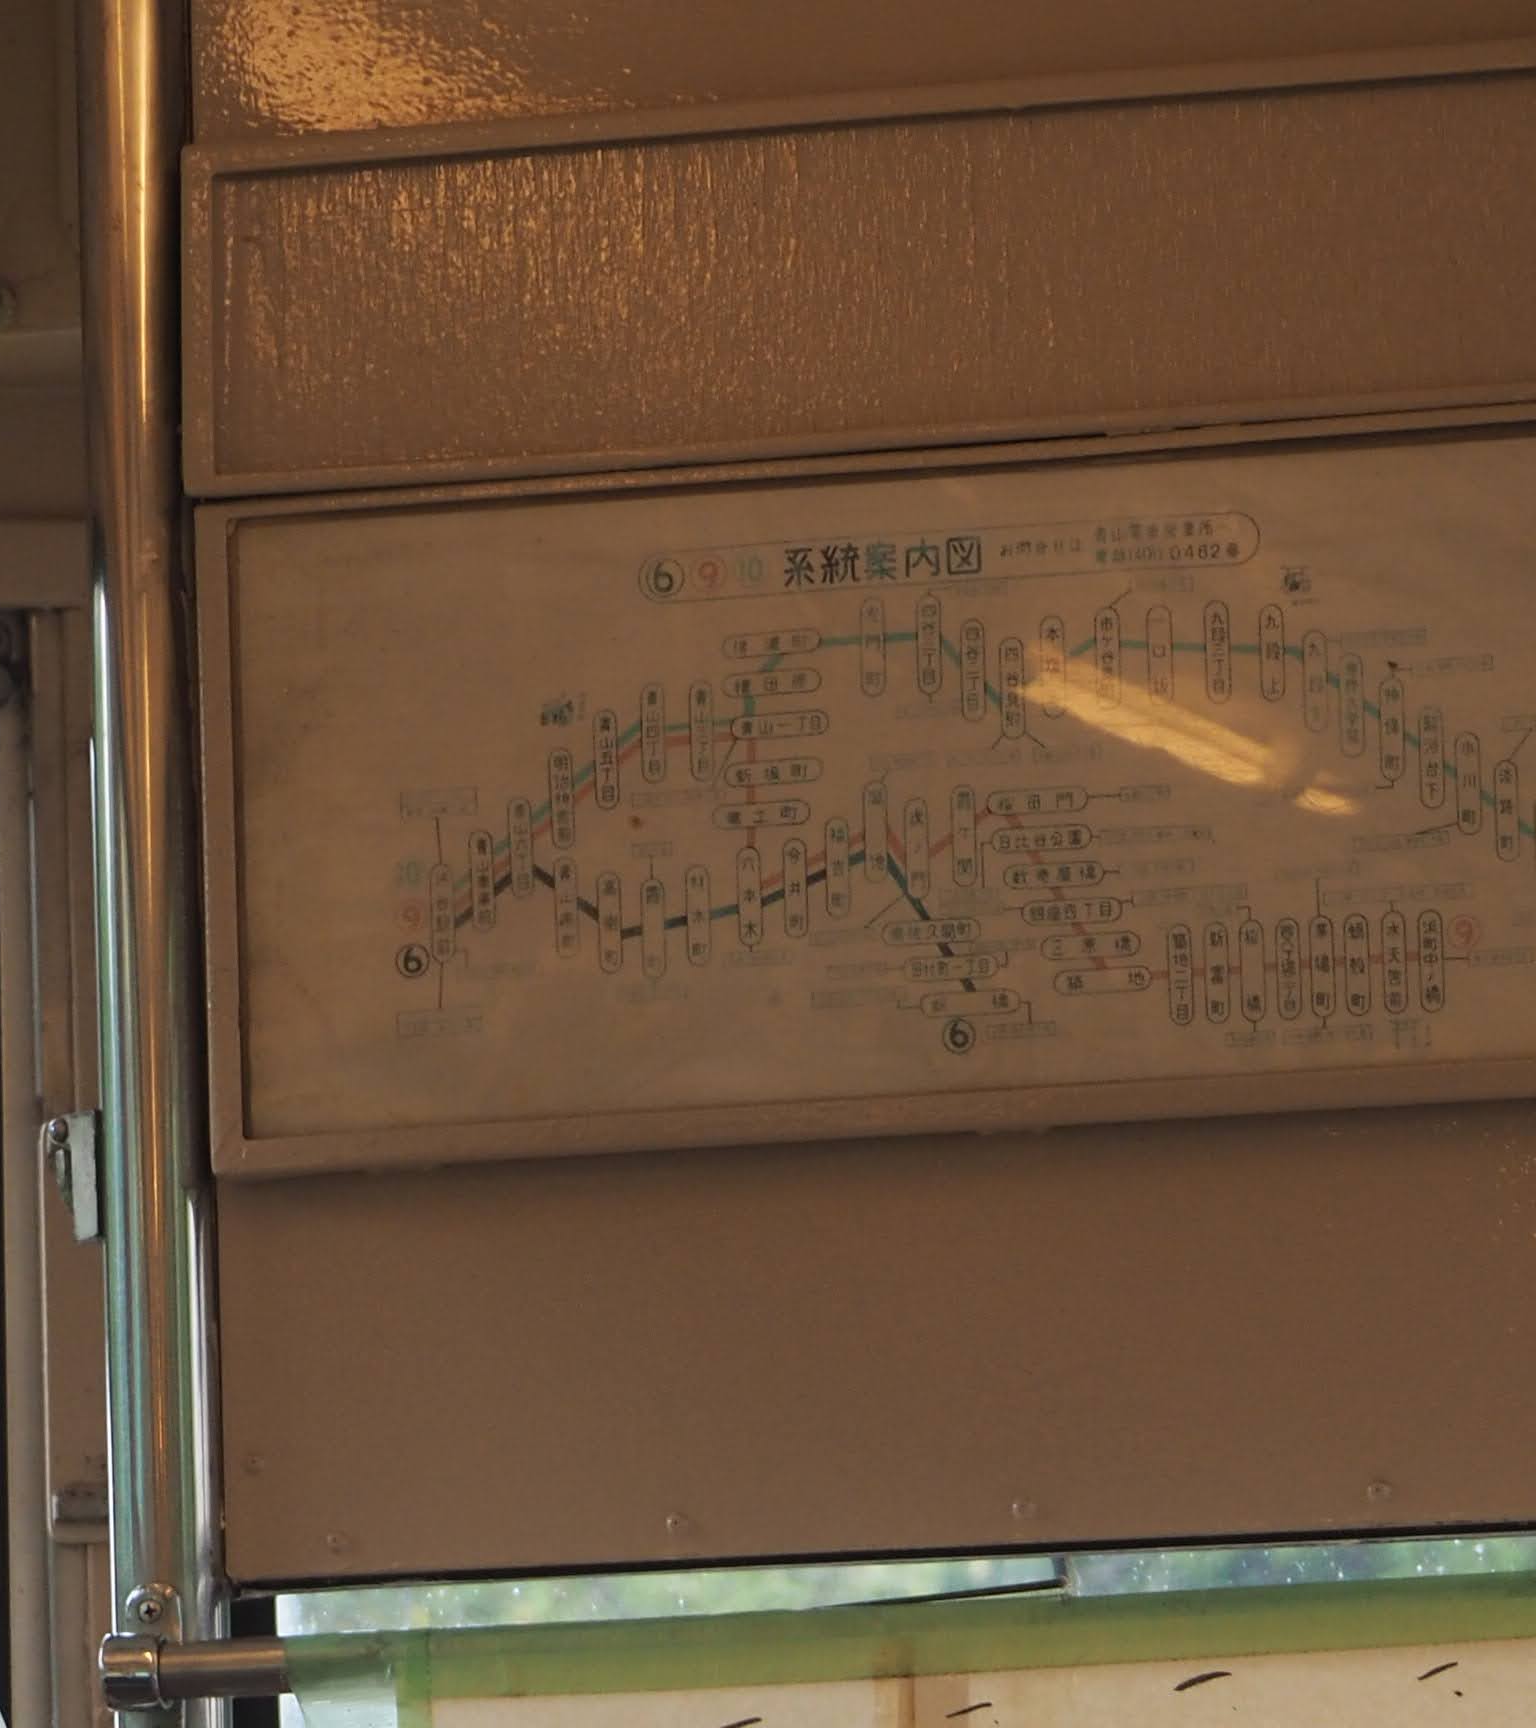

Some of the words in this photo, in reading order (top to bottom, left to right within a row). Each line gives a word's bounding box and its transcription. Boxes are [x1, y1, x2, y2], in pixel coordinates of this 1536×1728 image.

[652, 557, 676, 594] 6
[783, 536, 982, 587] 系統案内図
